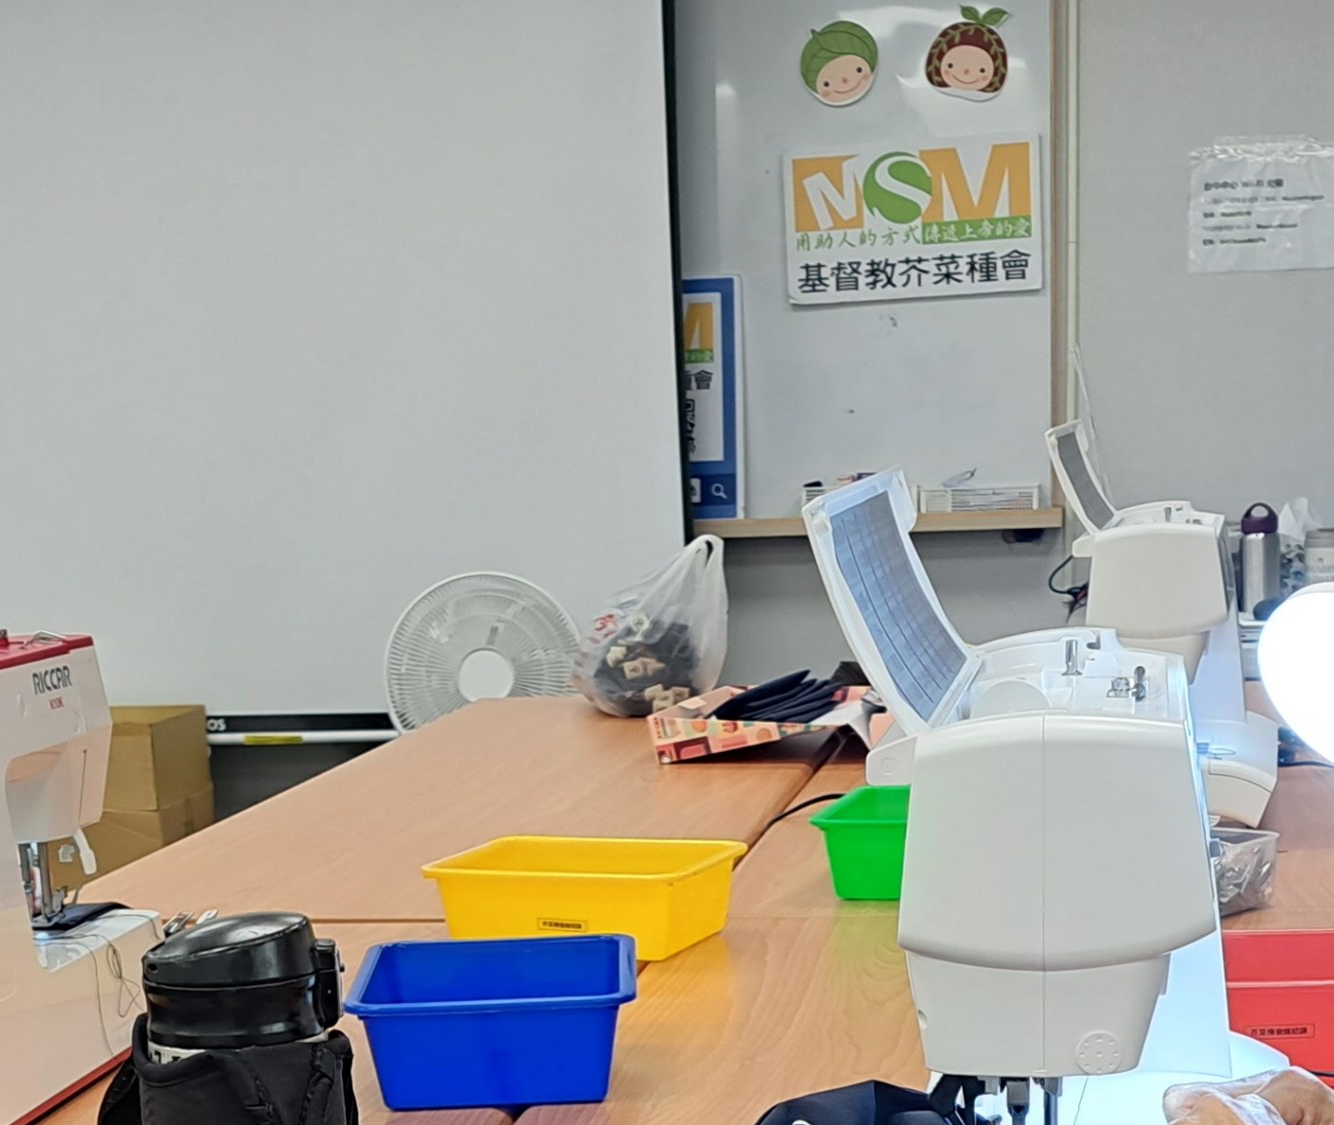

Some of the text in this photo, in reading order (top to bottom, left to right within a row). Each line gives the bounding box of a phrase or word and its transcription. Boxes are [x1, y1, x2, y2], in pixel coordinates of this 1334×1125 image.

[798, 249, 1031, 293] 基督教芥菜種會
[32, 665, 72, 695] RICCAR
